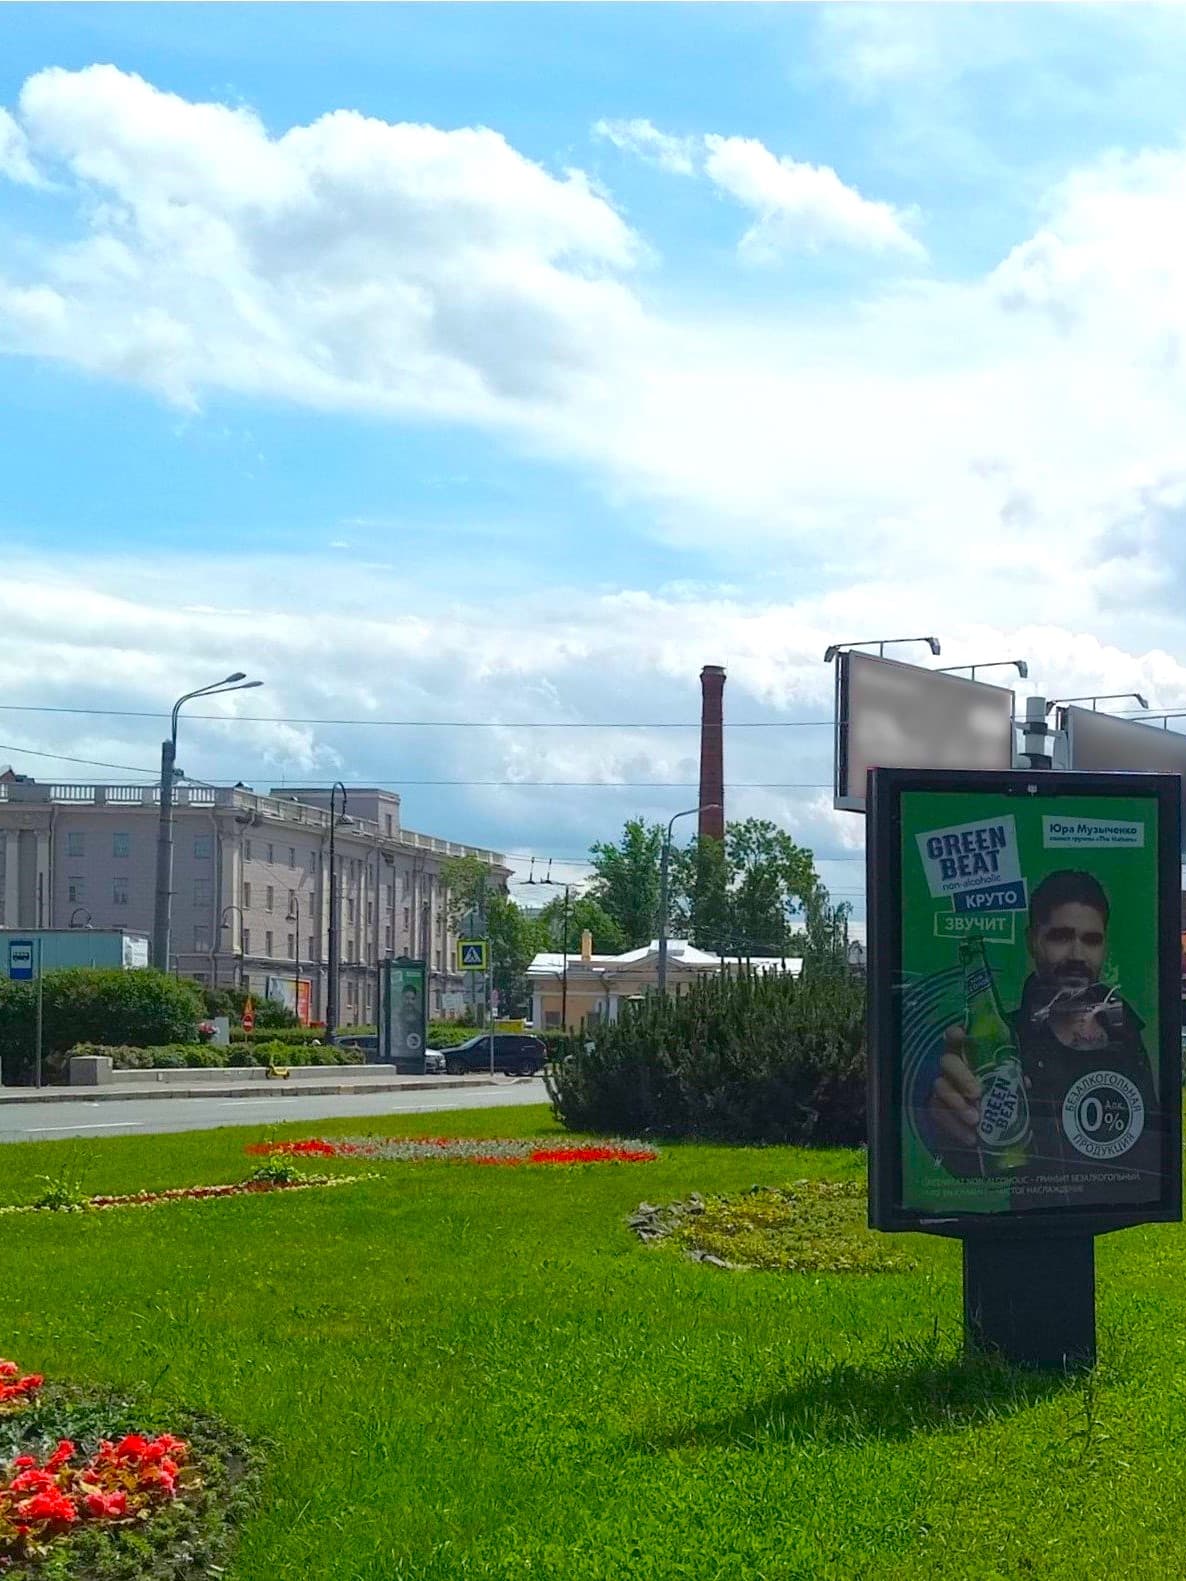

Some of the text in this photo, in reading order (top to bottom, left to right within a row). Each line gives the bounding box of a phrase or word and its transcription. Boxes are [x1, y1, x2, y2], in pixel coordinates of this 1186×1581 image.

[926, 825, 1007, 860] GREEN
[1050, 823, 1137, 836] Юра Музыченко
[938, 849, 1001, 882] BEAT
[942, 874, 1002, 891] non-alcoholic
[966, 890, 1018, 909] КРУТО
[944, 917, 1007, 931] ЗВУЧИТ
[980, 1076, 1011, 1135] GREEN
[1065, 1073, 1142, 1112] БЕЗАЛКОГОЛЬНАЯ
[995, 1090, 1018, 1130] BEAT
[1072, 1133, 1136, 1157] ПРОДУКЦИЯ
